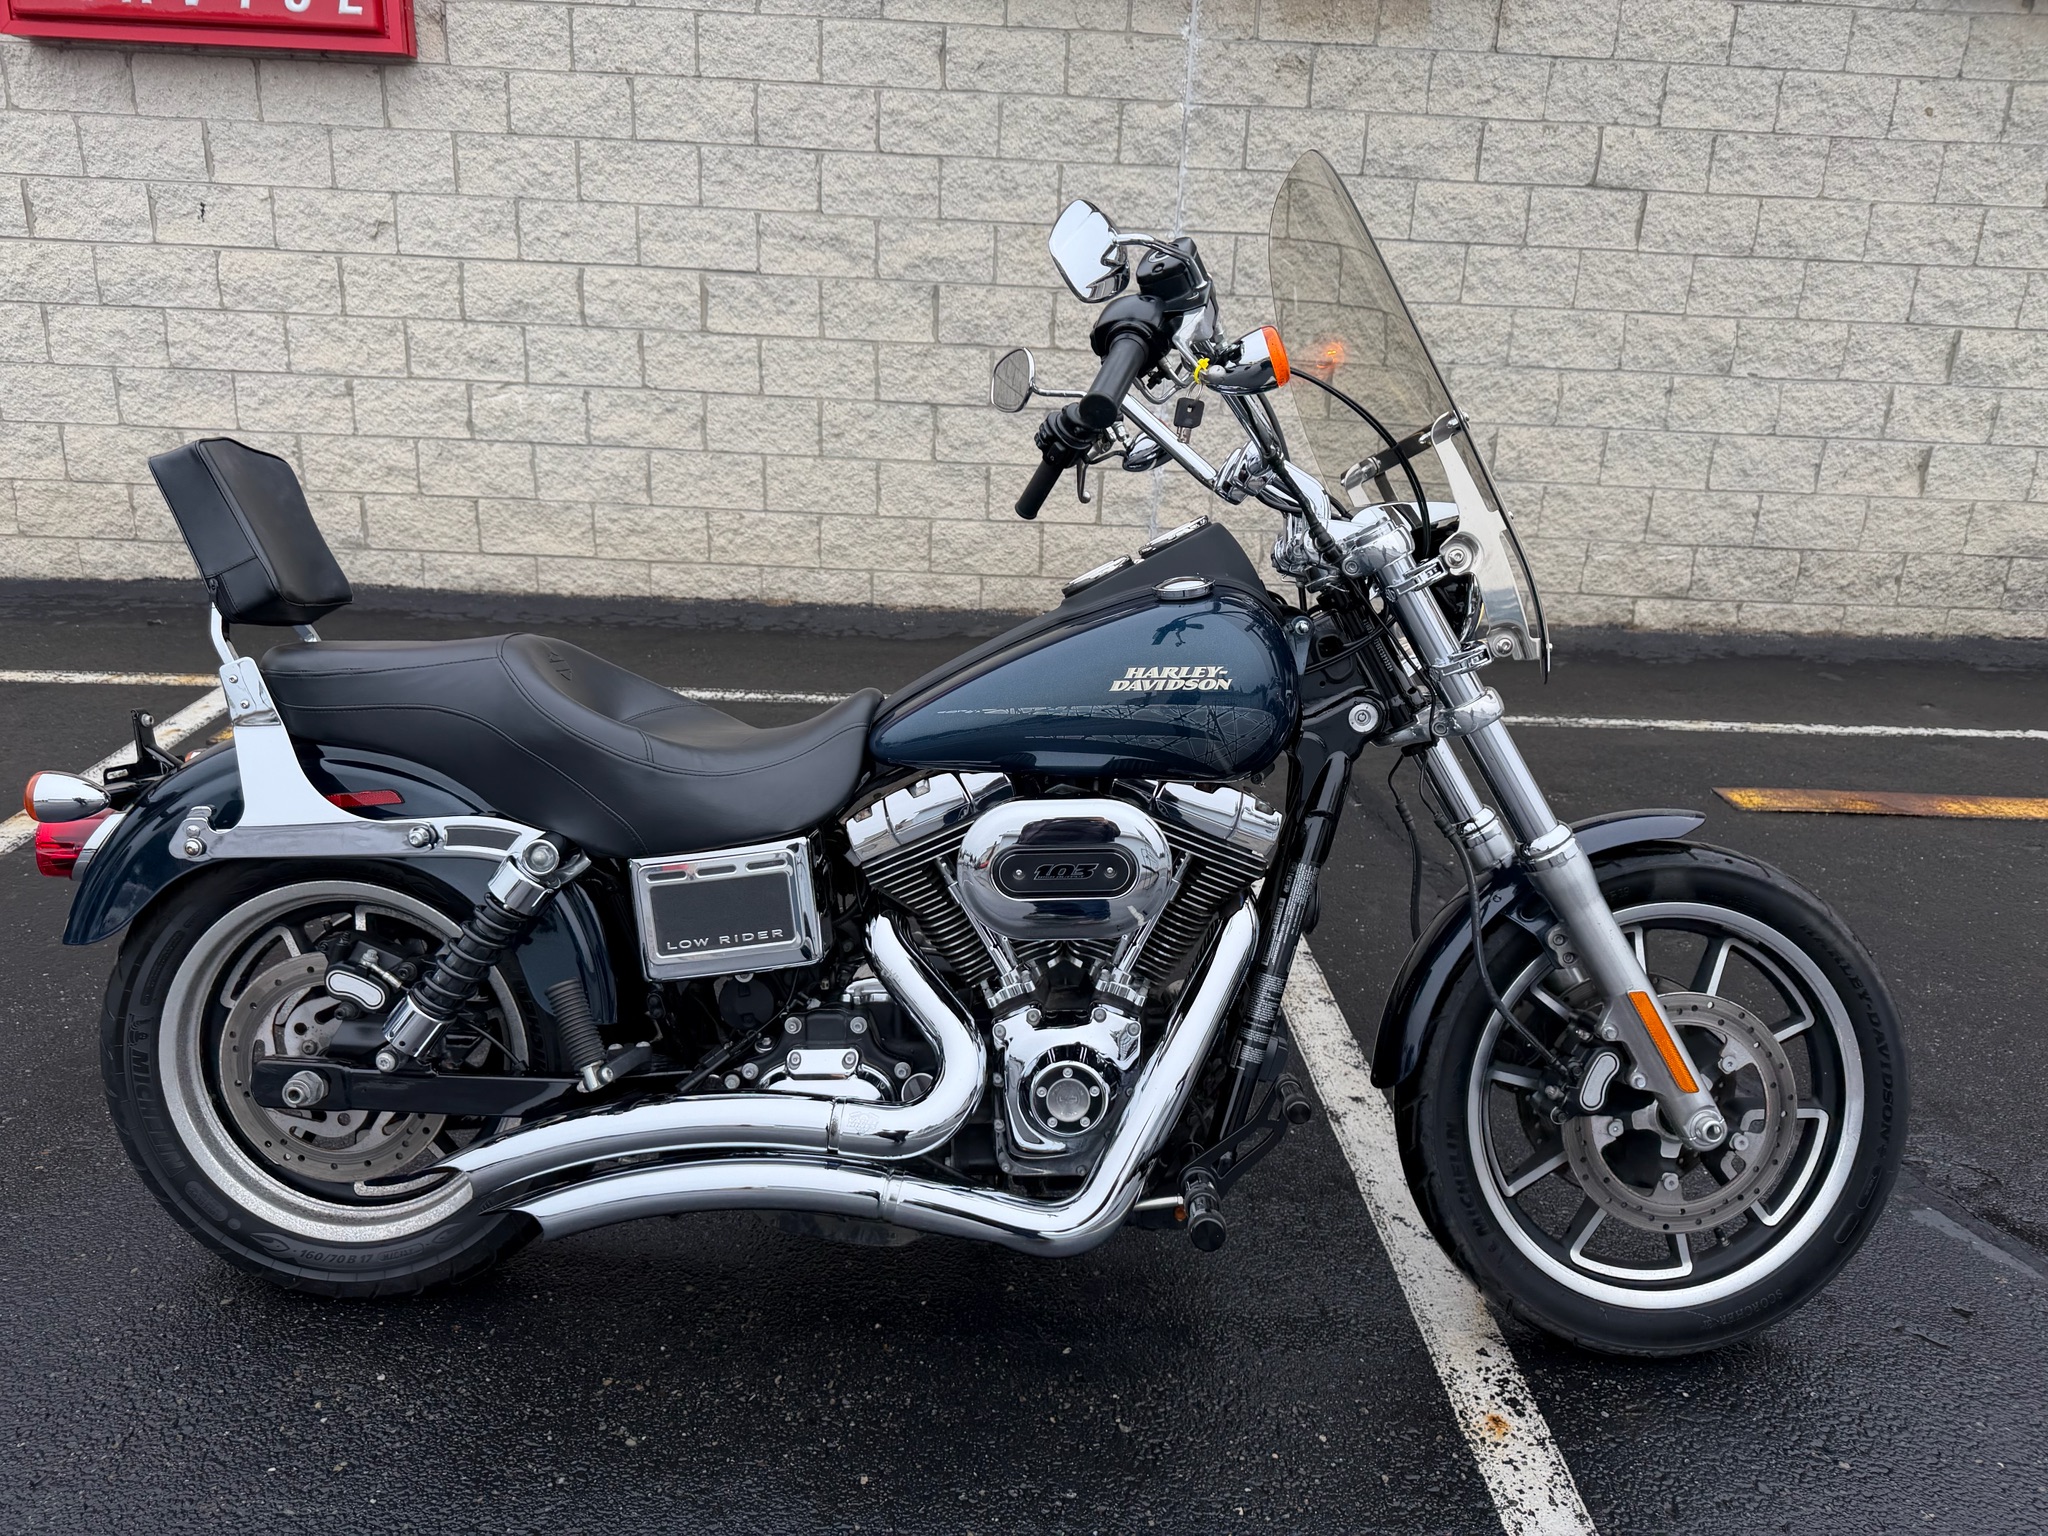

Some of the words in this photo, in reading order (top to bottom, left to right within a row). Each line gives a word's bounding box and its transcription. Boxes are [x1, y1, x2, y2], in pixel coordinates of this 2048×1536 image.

[1124, 666, 1228, 679] HARLEY-
[1109, 678, 1233, 692] DAVIDSON
[1034, 863, 1099, 880] 103
[666, 937, 709, 950] LOW
[719, 929, 784, 945] RIDER
[1718, 1288, 1783, 1325] SCORCHER
